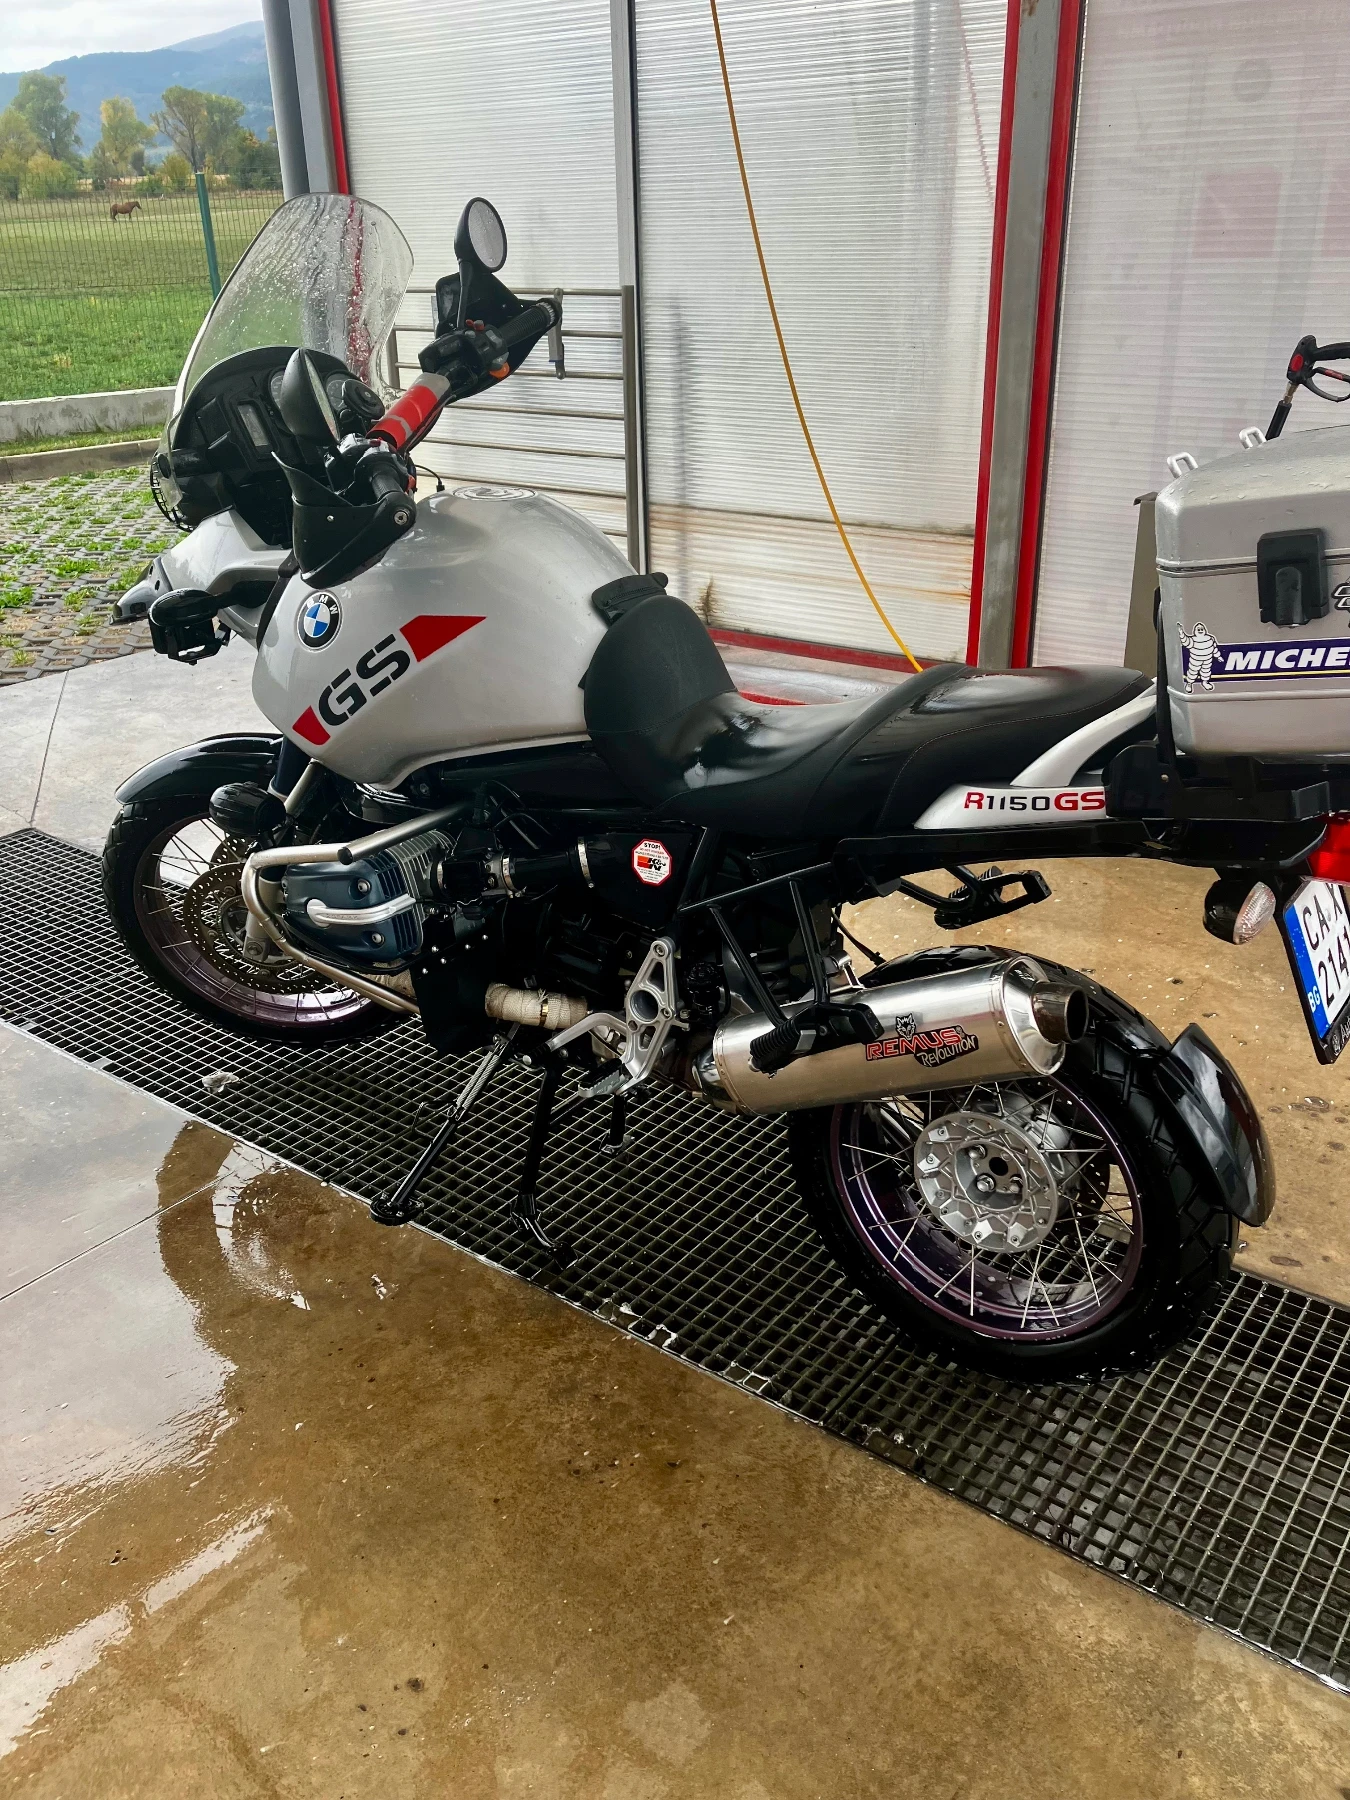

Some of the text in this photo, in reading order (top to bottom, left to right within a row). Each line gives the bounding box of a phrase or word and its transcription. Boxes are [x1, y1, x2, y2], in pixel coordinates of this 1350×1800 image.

[306, 594, 338, 615] BMW
[1224, 646, 1350, 671] MICHE
[318, 633, 411, 727] GS
[964, 791, 1106, 811] R1150GS
[1303, 894, 1331, 951] CA
[1307, 985, 1321, 1014] BG
[866, 1028, 962, 1060] REMUS
